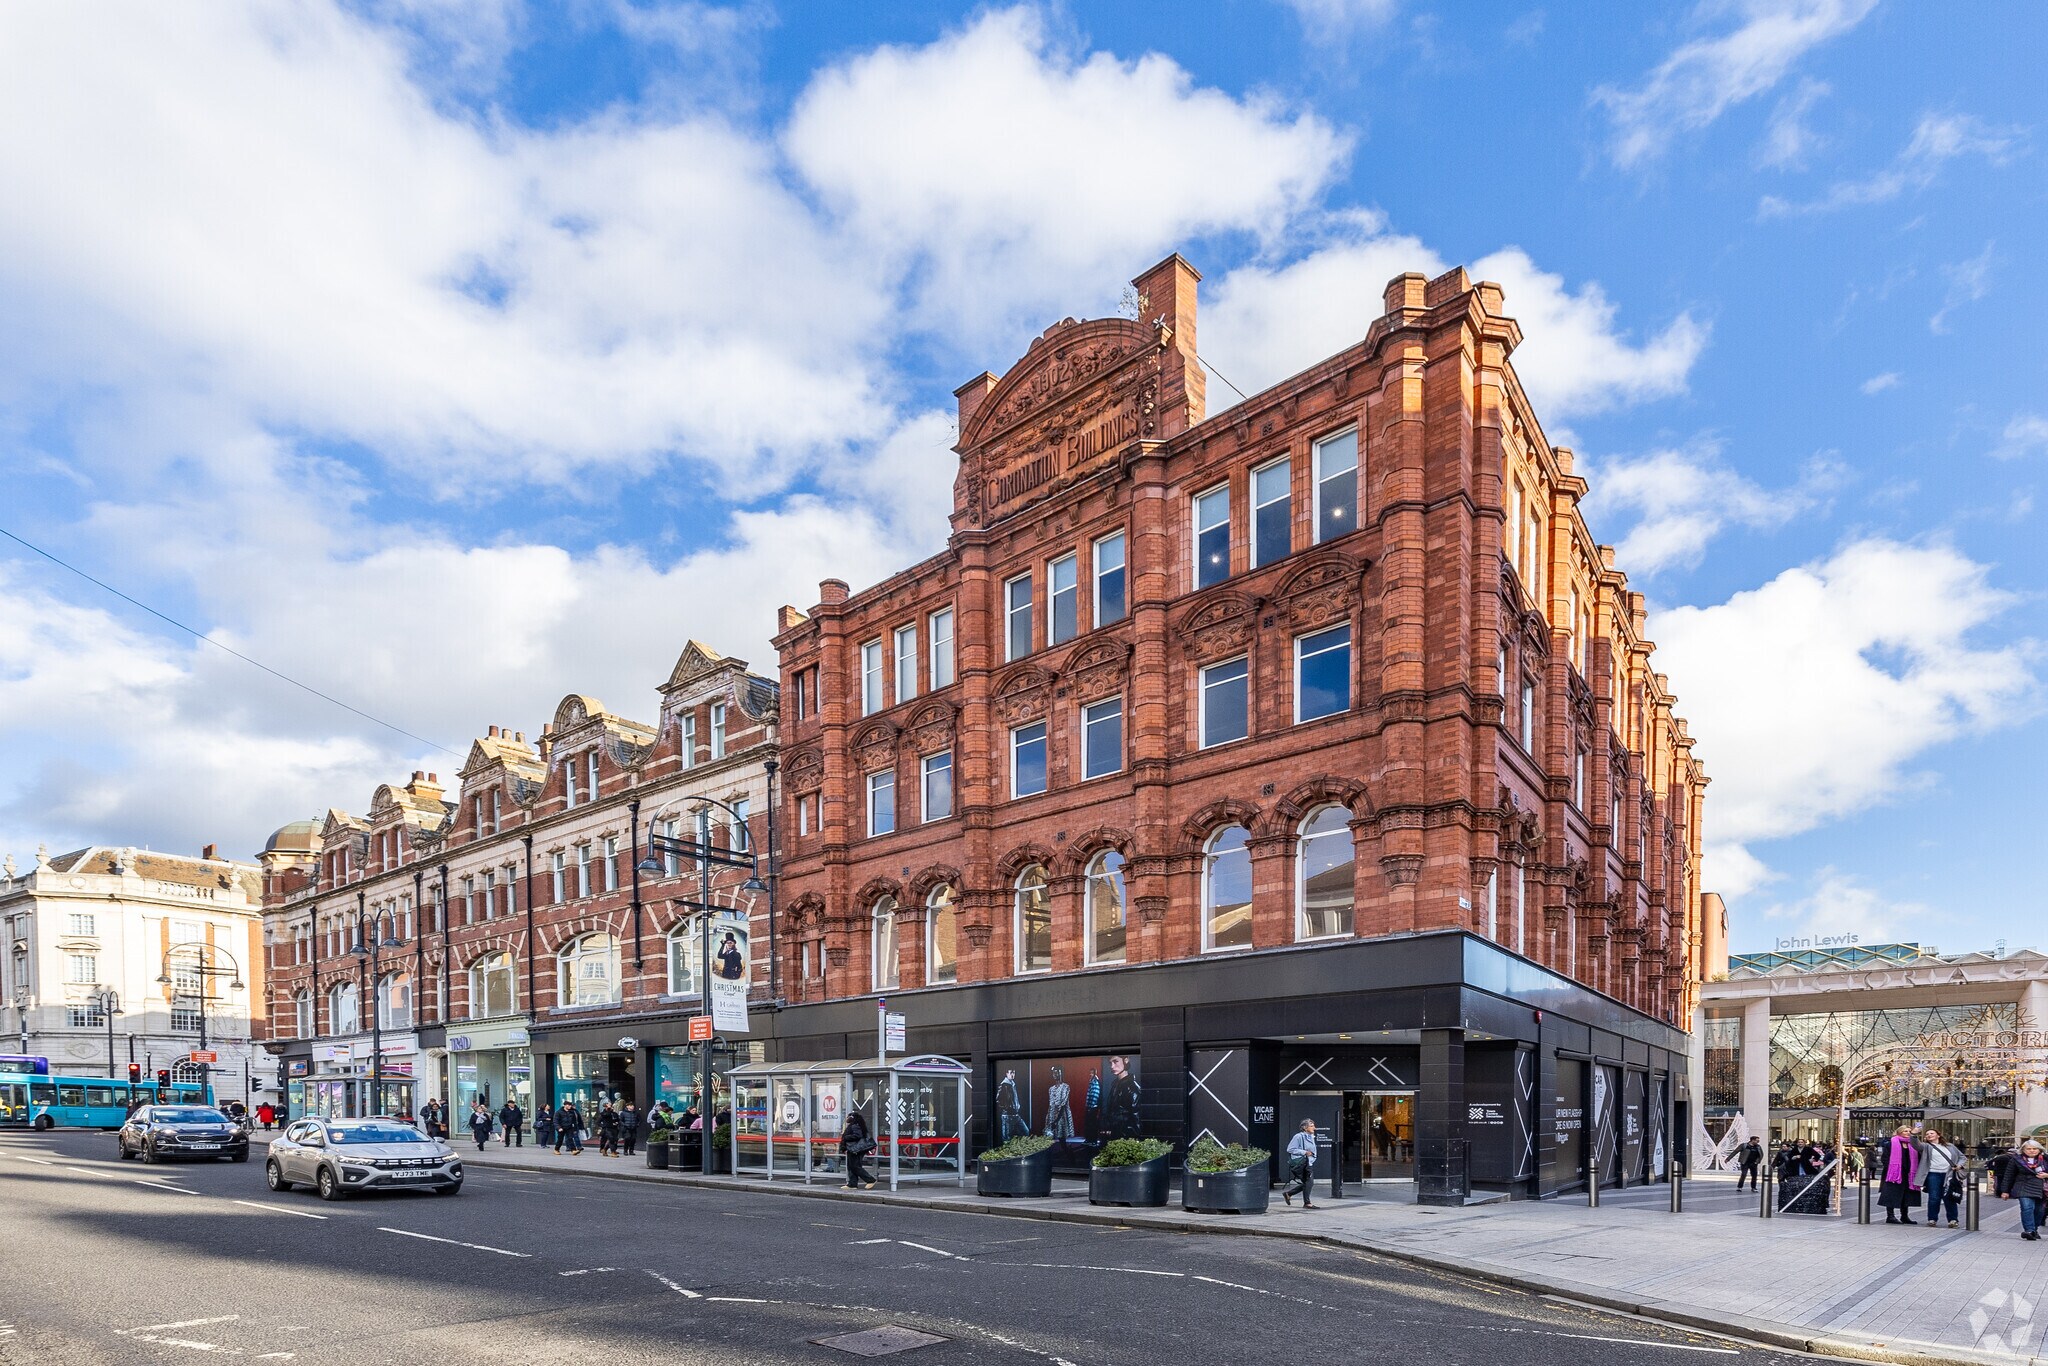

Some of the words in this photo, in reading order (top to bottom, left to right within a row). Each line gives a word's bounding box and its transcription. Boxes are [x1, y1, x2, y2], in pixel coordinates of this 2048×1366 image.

[1037, 361, 1071, 396] 1902
[986, 446, 1061, 510] CORONATION
[1066, 406, 1139, 471] BUILDINGS
[1774, 937, 1810, 951] John
[1814, 932, 1859, 946] Lewis
[714, 982, 744, 994] CHRISTMAS
[1770, 964, 1968, 992] VICTORIA
[1253, 1113, 1275, 1122] LANE
